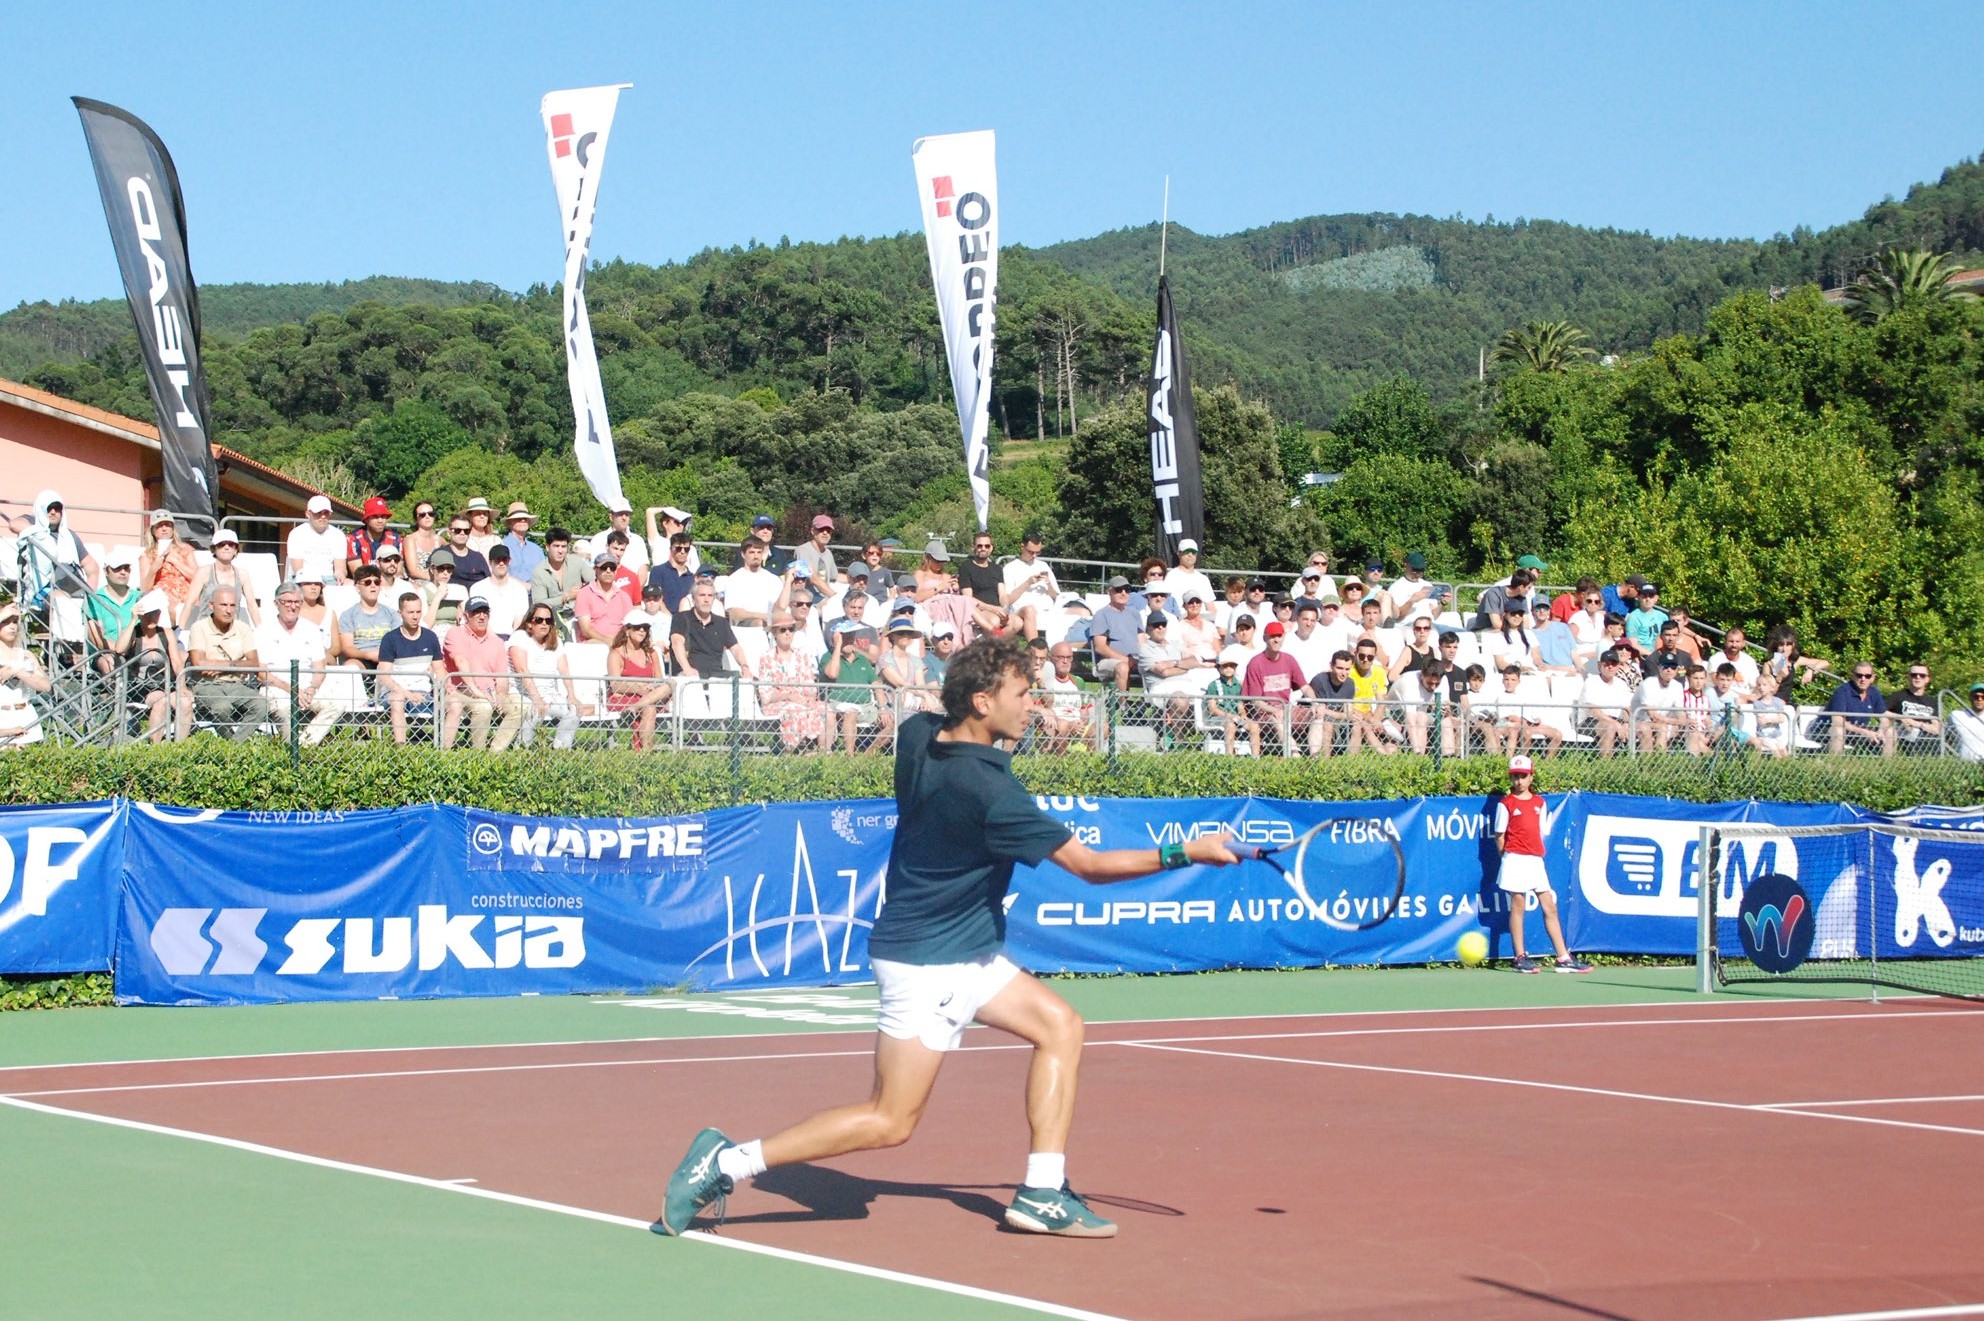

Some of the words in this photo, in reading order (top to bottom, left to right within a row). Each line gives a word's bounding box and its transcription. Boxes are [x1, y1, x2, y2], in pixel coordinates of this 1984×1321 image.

[127, 175, 199, 429] HEAD
[1151, 329, 1183, 535] HEAD
[247, 811, 291, 824] NEW
[295, 810, 345, 824] IDEAS
[856, 815, 881, 828] ner
[1330, 816, 1402, 844] FIBRA
[510, 823, 704, 860] MAPFRE
[471, 892, 584, 910] construcciones
[1036, 900, 1216, 926] CUPRA
